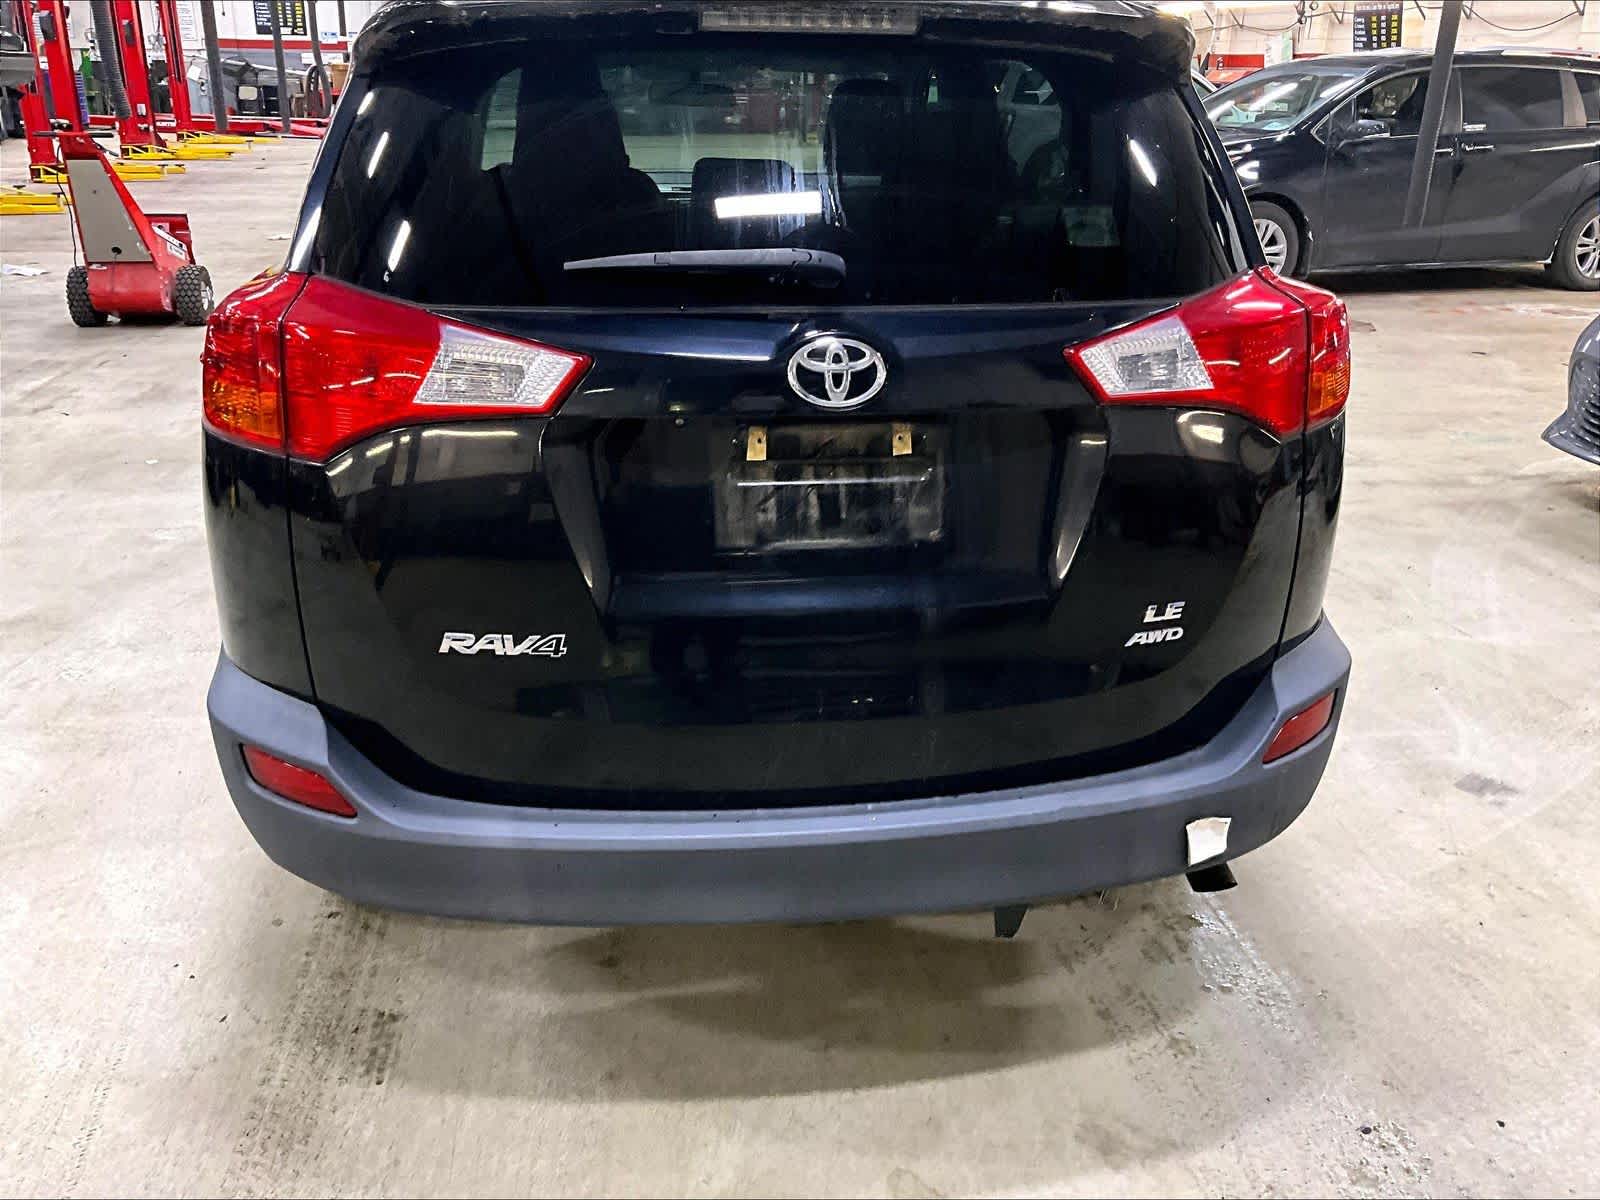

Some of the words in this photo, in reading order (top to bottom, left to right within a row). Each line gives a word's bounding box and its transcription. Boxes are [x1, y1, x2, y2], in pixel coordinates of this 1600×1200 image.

[1143, 601, 1186, 623] LE
[438, 631, 568, 657] RAV4
[1124, 626, 1184, 647] AWD
